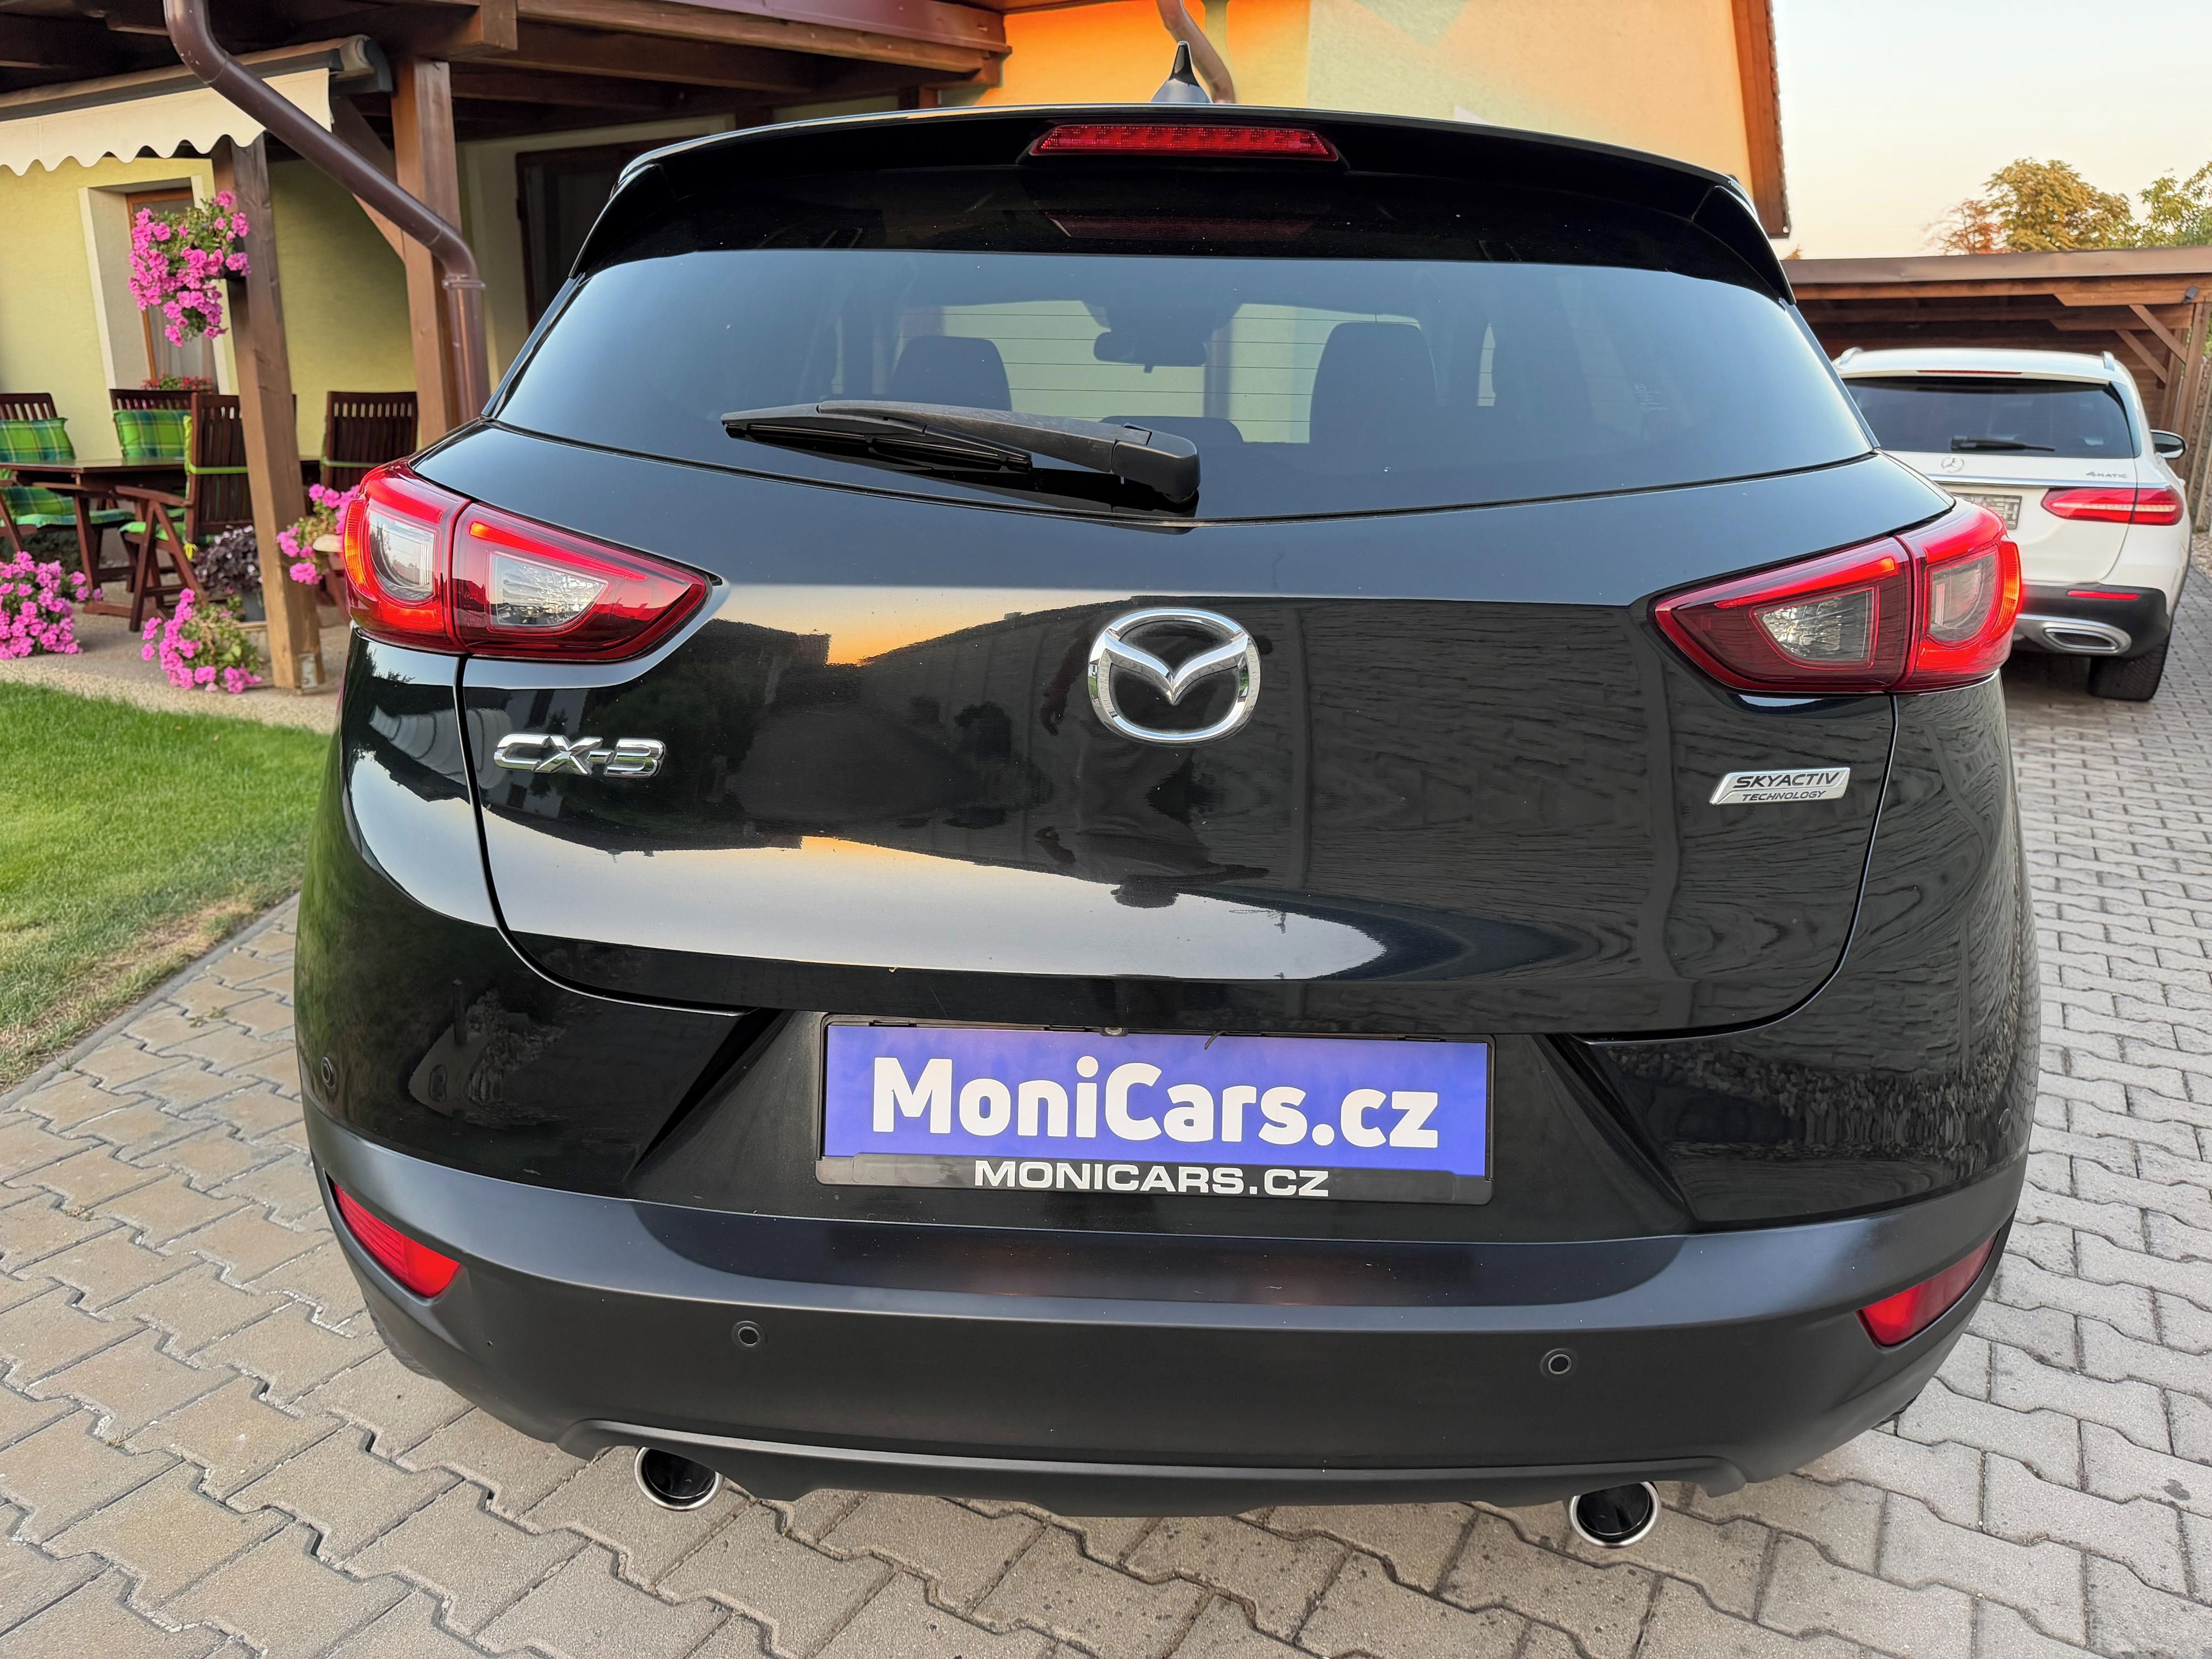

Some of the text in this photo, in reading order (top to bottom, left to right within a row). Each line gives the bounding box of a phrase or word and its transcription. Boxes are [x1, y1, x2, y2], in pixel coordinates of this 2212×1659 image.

[494, 733, 665, 777] CX-3
[1732, 772, 1839, 788] SKYACTIV
[1742, 790, 1826, 801] TECHNOLOGY
[872, 1055, 1439, 1149] MoniCars.cz
[974, 1159, 1330, 1197] MONICARS.CZ
